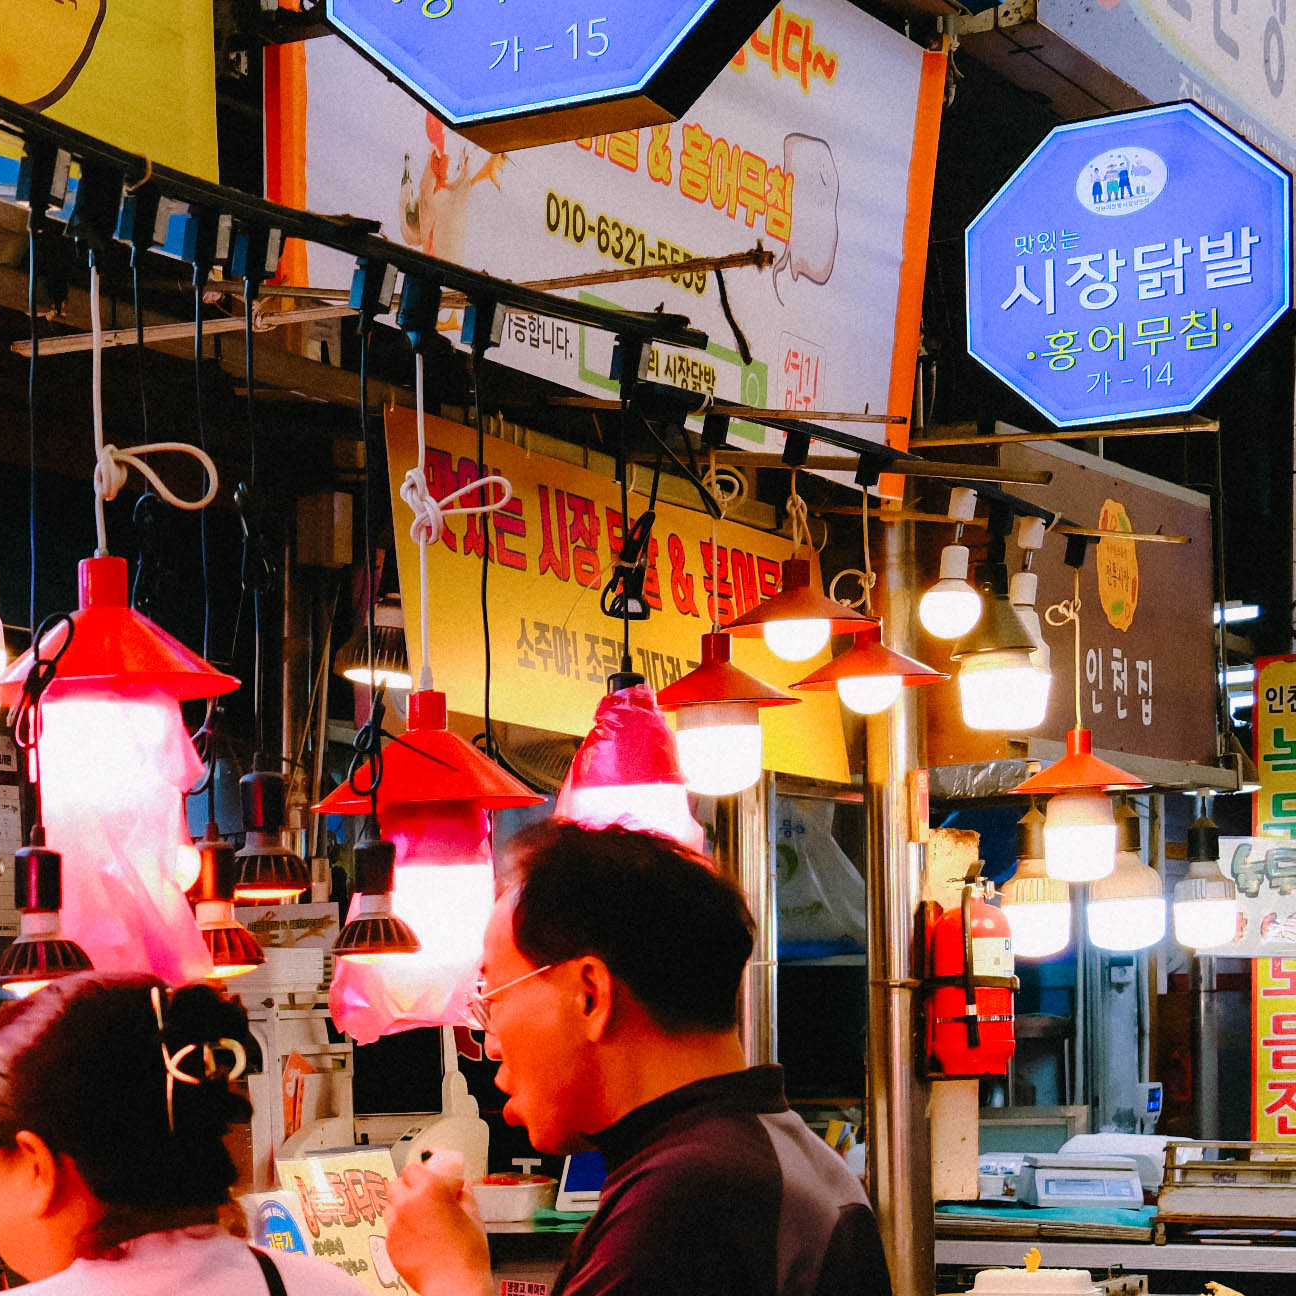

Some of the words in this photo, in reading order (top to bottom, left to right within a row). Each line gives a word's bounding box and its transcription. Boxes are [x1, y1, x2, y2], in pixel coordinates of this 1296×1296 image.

[679, 122, 794, 243] 홍어무침
[1000, 226, 1261, 315] 시장닭발
[1014, 229, 1081, 257] 맛있는
[538, 483, 602, 590] 시장
[668, 532, 701, 618] &
[1085, 648, 1153, 727] 인천집
